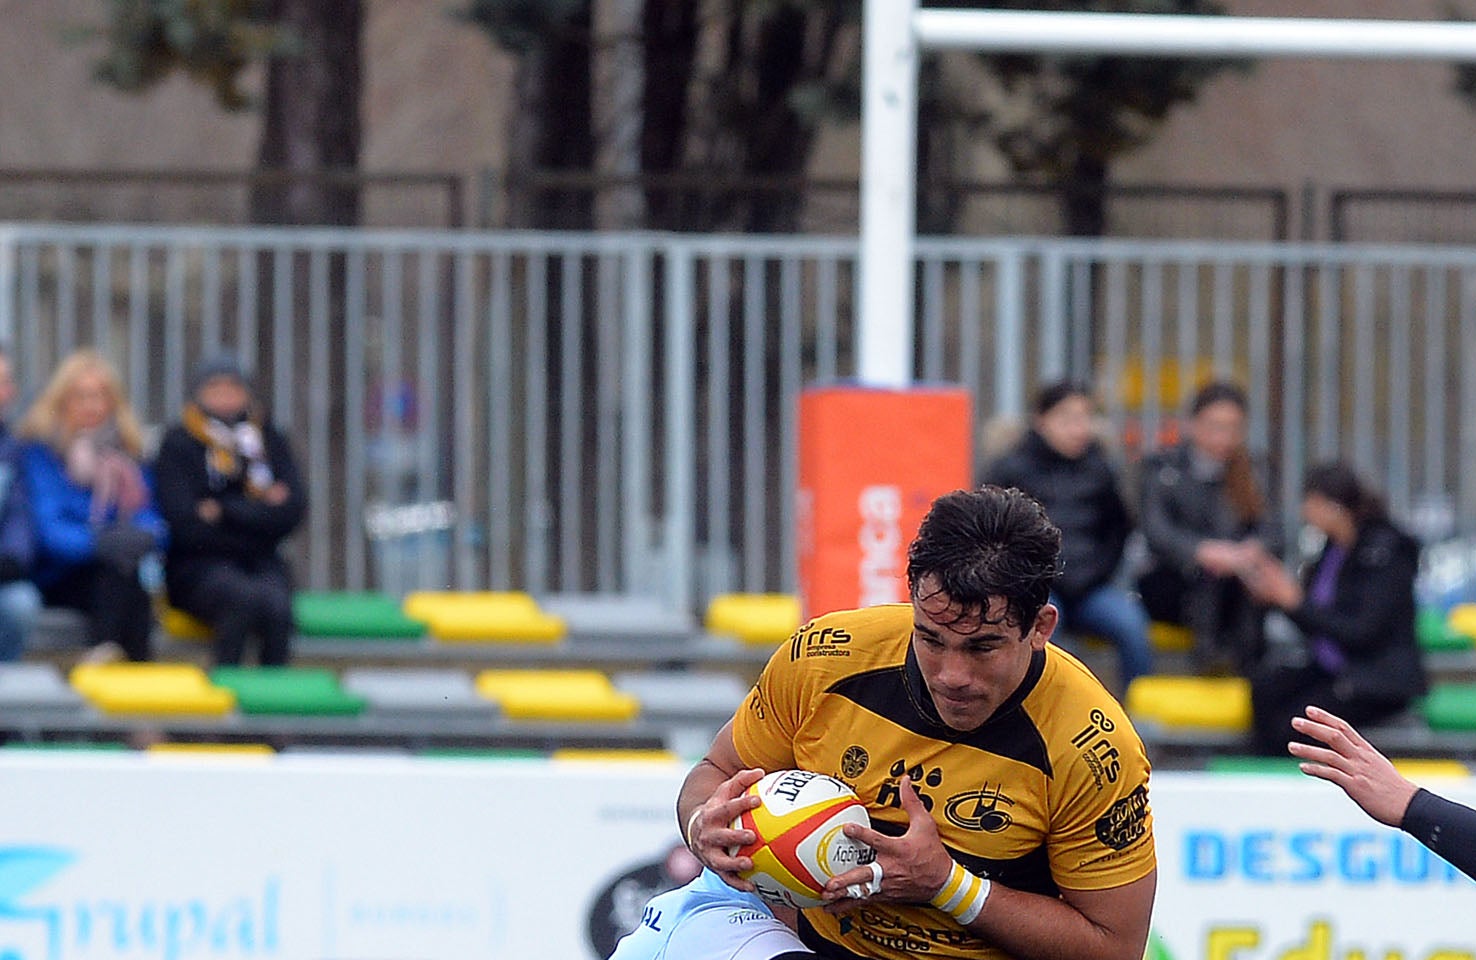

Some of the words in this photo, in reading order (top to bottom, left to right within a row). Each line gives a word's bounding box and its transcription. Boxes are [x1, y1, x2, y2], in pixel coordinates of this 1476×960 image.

[807, 627, 852, 646] rfs
[1093, 739, 1120, 784] rfs
[1184, 829, 1457, 882] DESGU
